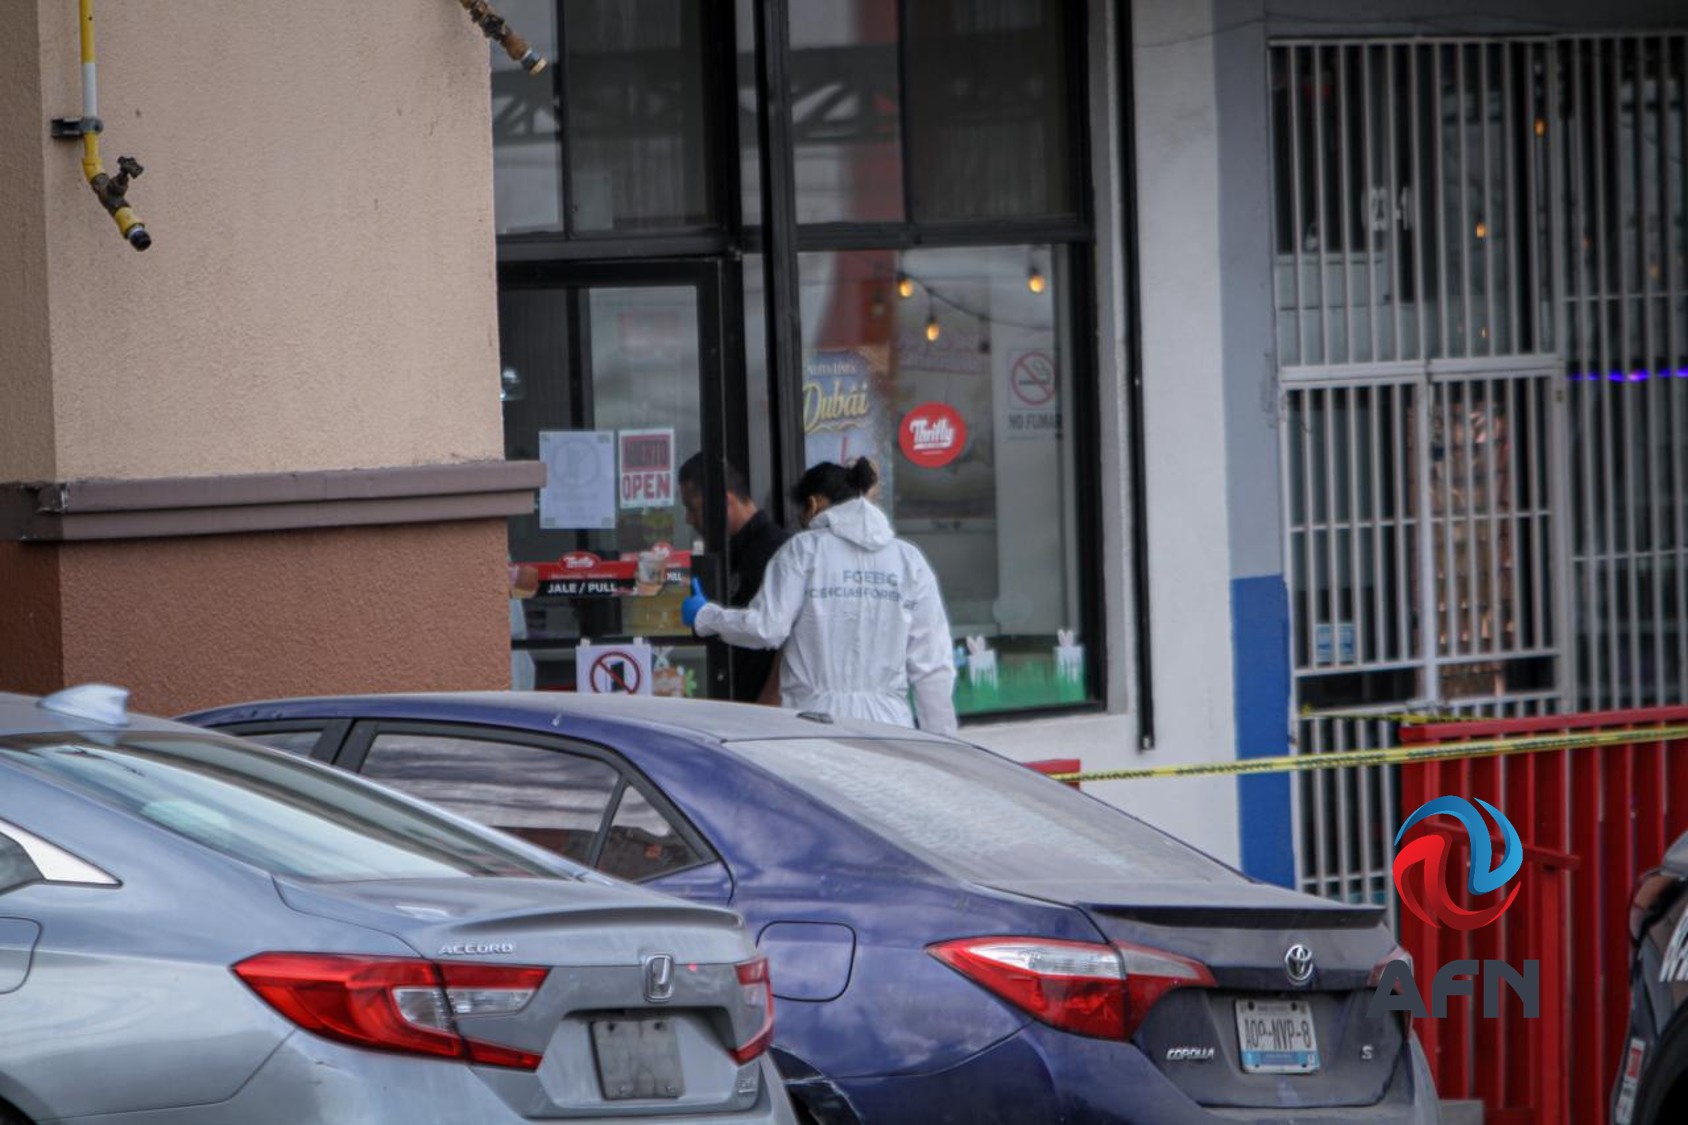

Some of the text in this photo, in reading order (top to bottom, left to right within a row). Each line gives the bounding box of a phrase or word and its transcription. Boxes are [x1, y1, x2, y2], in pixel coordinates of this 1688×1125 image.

[909, 417, 954, 450] Thrifty
[622, 473, 671, 500] OPEN
[548, 583, 577, 594] JALE
[587, 582, 616, 593] PULL
[438, 943, 513, 955] ACCORD
[1361, 1045, 1373, 1060] S
